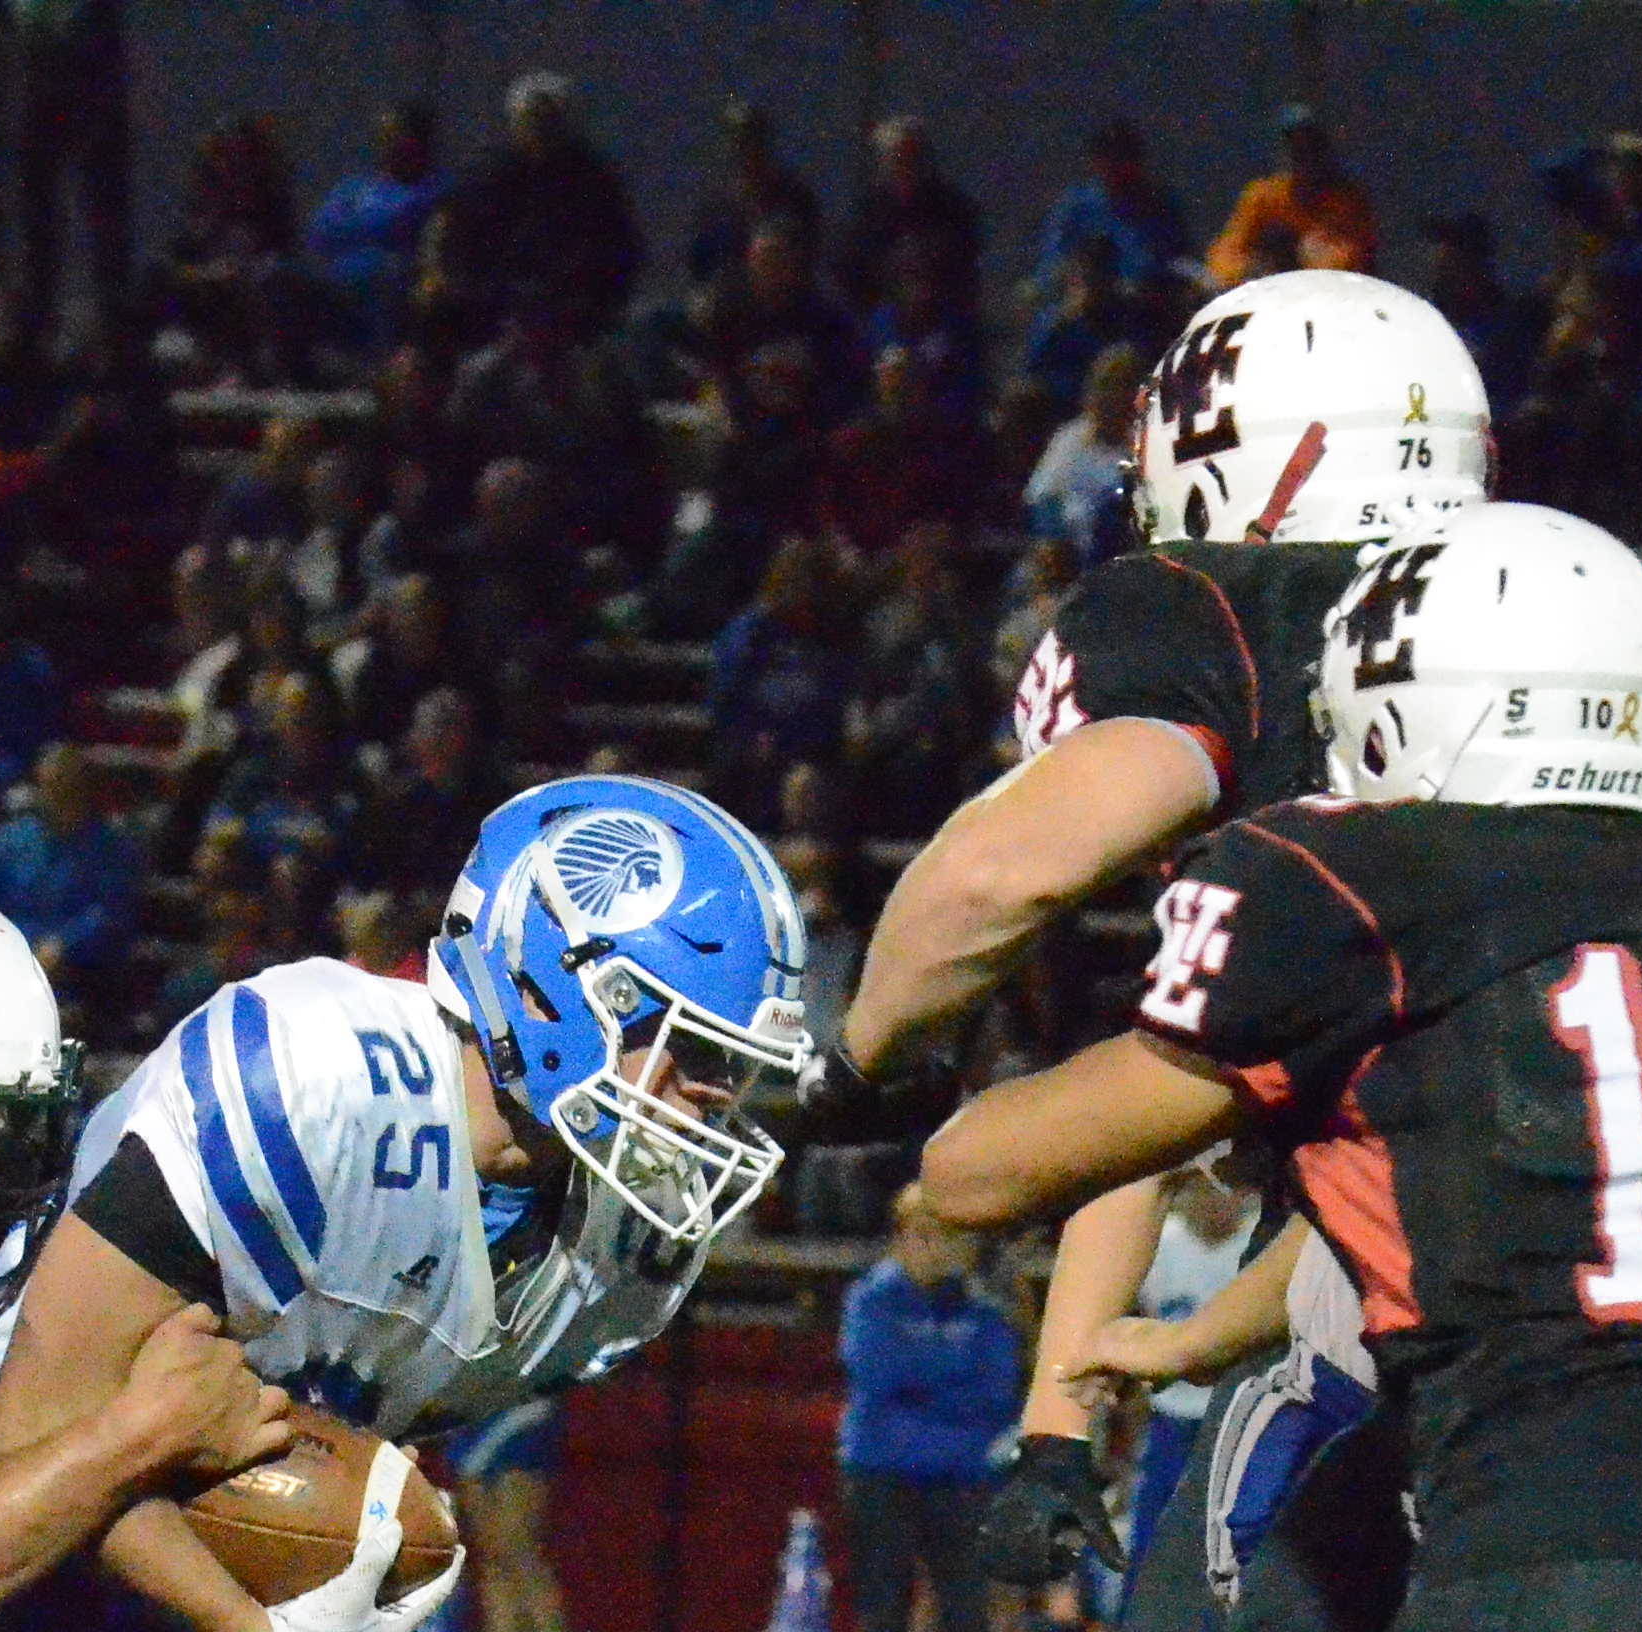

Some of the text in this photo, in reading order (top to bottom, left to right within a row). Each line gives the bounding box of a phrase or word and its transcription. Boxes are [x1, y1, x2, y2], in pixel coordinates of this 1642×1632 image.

[1398, 437, 1432, 471] 76
[1579, 698, 1613, 729] 10
[356, 1028, 452, 1192] 25
